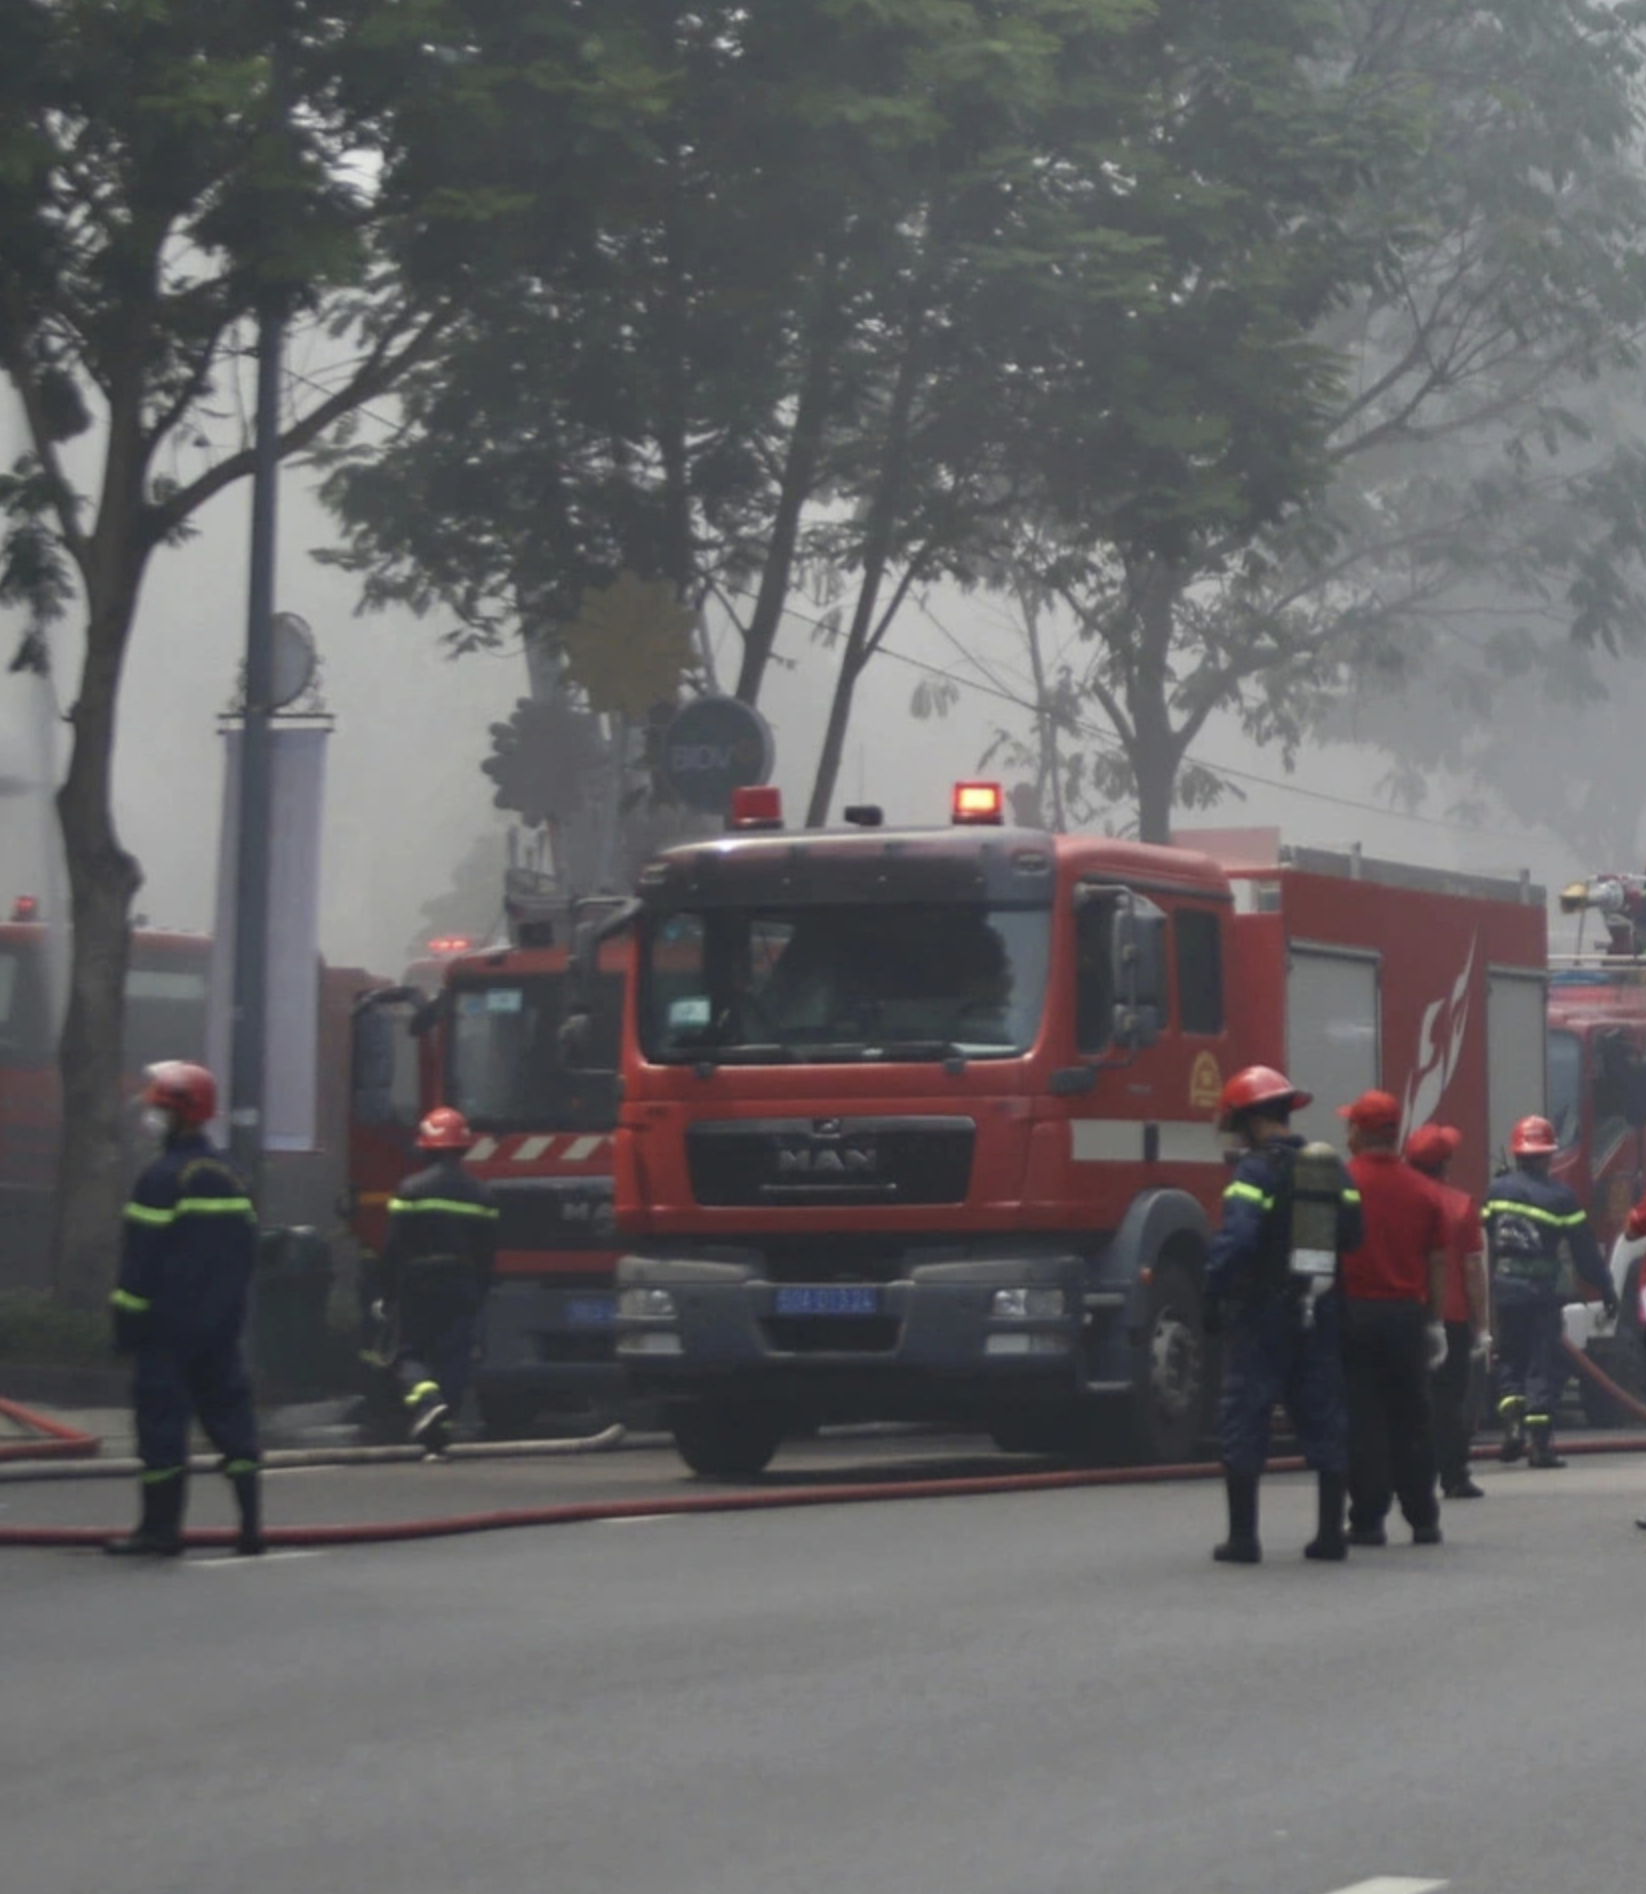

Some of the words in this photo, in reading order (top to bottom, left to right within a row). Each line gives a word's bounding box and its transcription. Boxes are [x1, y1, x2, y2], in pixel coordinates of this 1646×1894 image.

[671, 744, 735, 771] BIDV
[779, 1149, 876, 1172] MAN
[562, 1202, 613, 1221] MA
